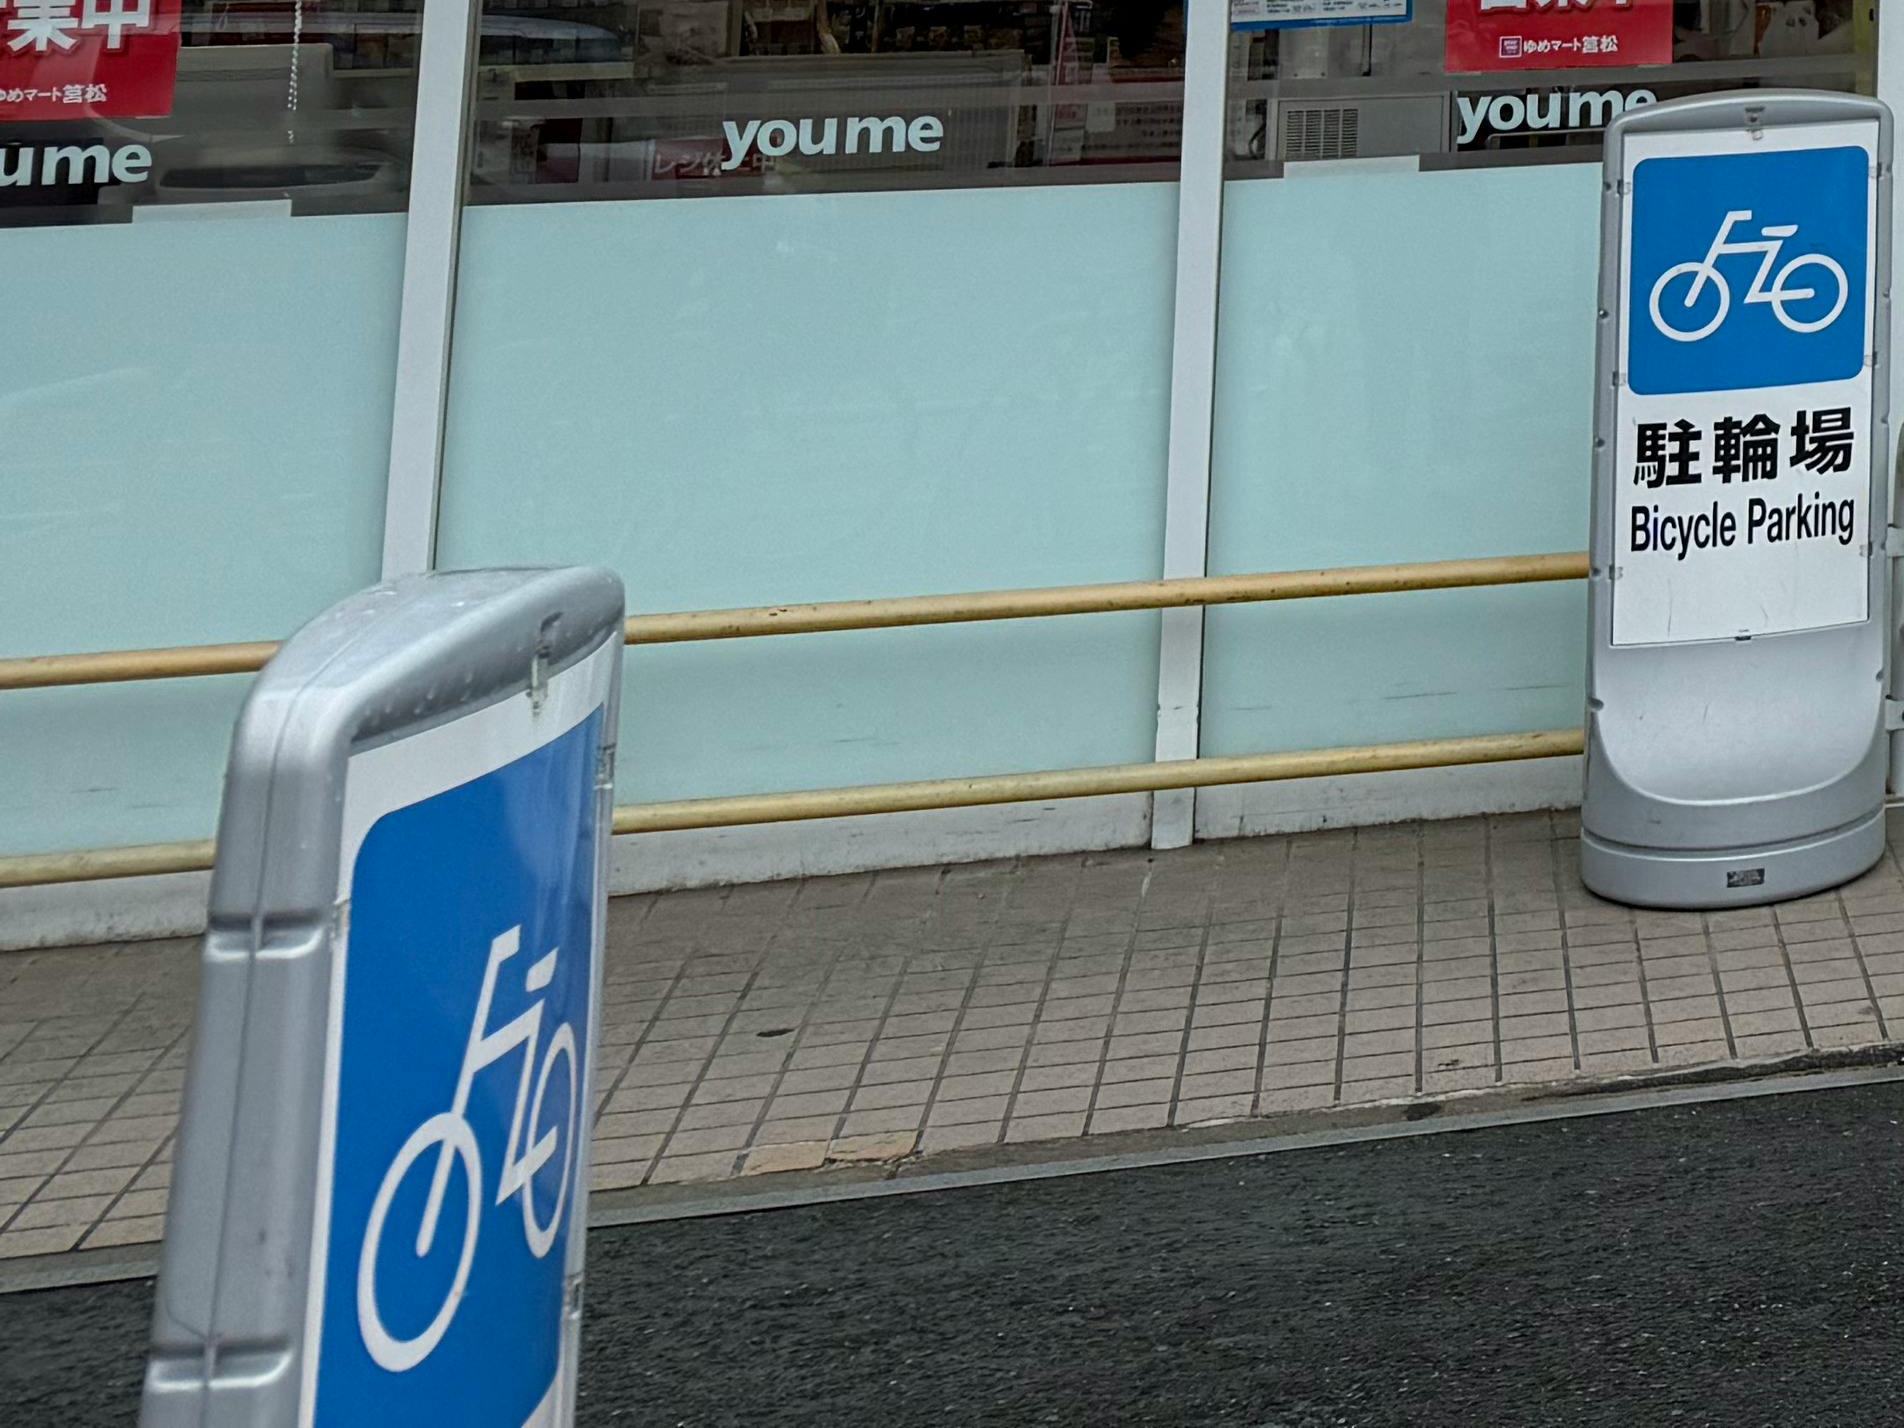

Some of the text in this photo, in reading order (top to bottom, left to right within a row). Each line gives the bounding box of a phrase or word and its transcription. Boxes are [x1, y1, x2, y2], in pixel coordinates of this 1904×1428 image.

[721, 114, 945, 171] youme
[1632, 406, 1854, 489] 駐輪場
[1631, 491, 1855, 562] Bicycle Parking
